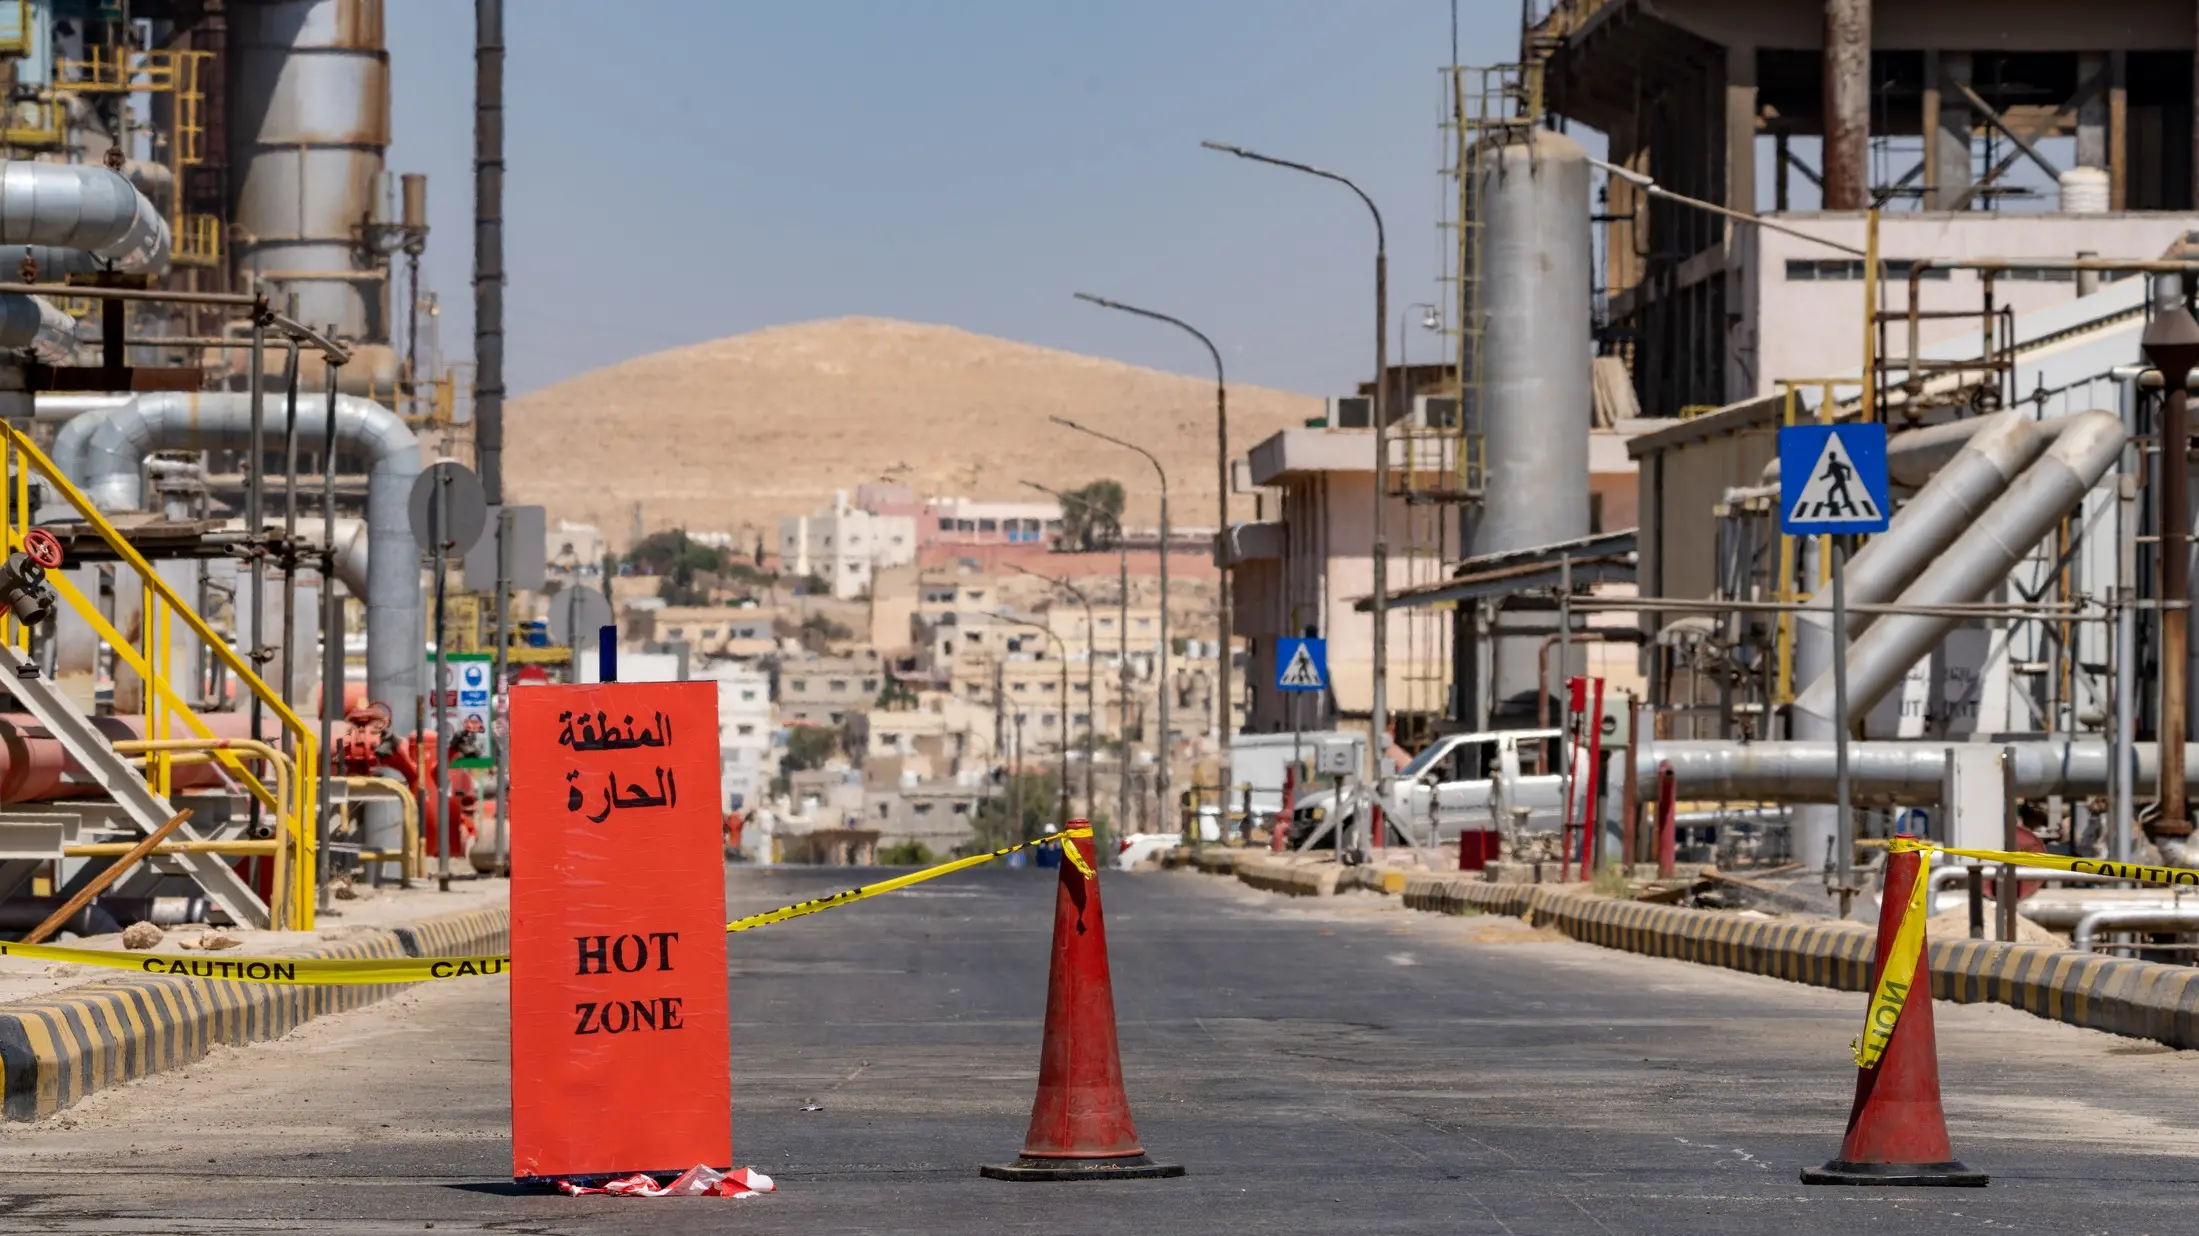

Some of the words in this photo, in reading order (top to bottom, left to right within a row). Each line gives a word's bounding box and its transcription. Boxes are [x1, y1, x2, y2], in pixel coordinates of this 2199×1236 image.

[558, 710, 672, 751] المنطقة
[566, 765, 677, 824] الحارة
[142, 958, 295, 981] CAUTION
[573, 932, 679, 976] HOT
[574, 997, 684, 1035] ZONE
